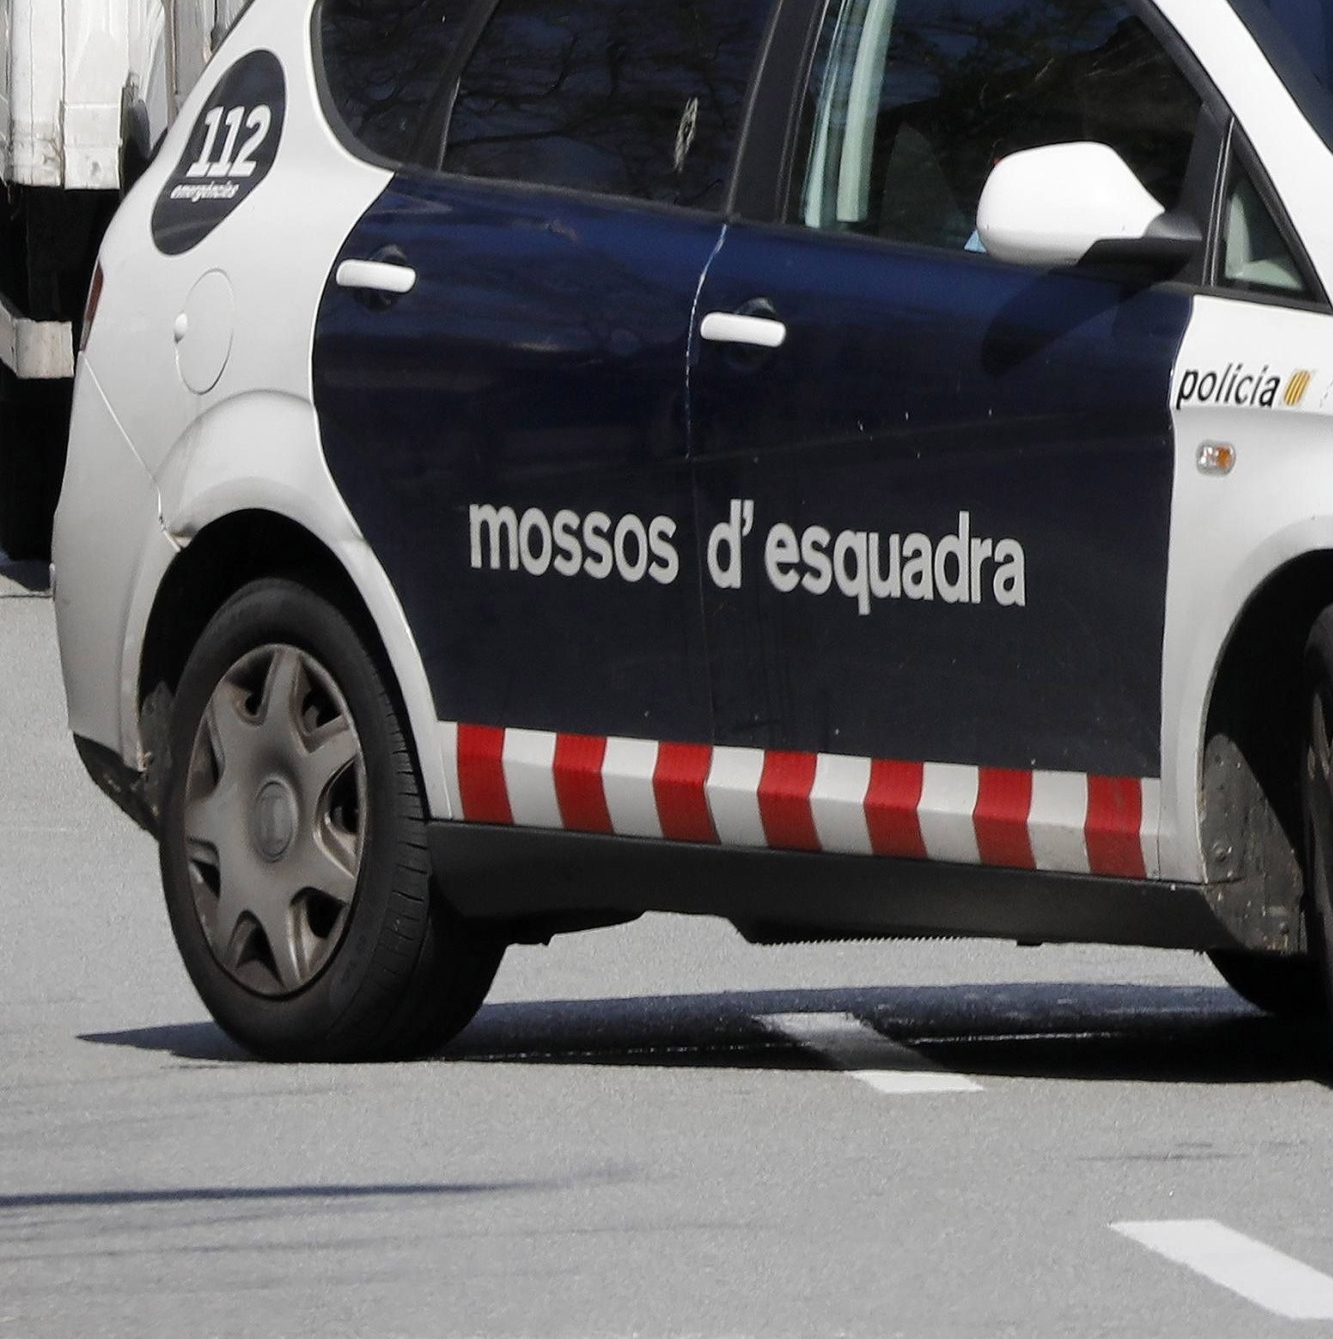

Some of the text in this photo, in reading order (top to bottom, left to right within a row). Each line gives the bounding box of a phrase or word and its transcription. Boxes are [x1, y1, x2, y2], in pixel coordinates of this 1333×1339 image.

[186, 104, 272, 177] 112
[1176, 363, 1281, 410] policia
[469, 503, 680, 584] mossos
